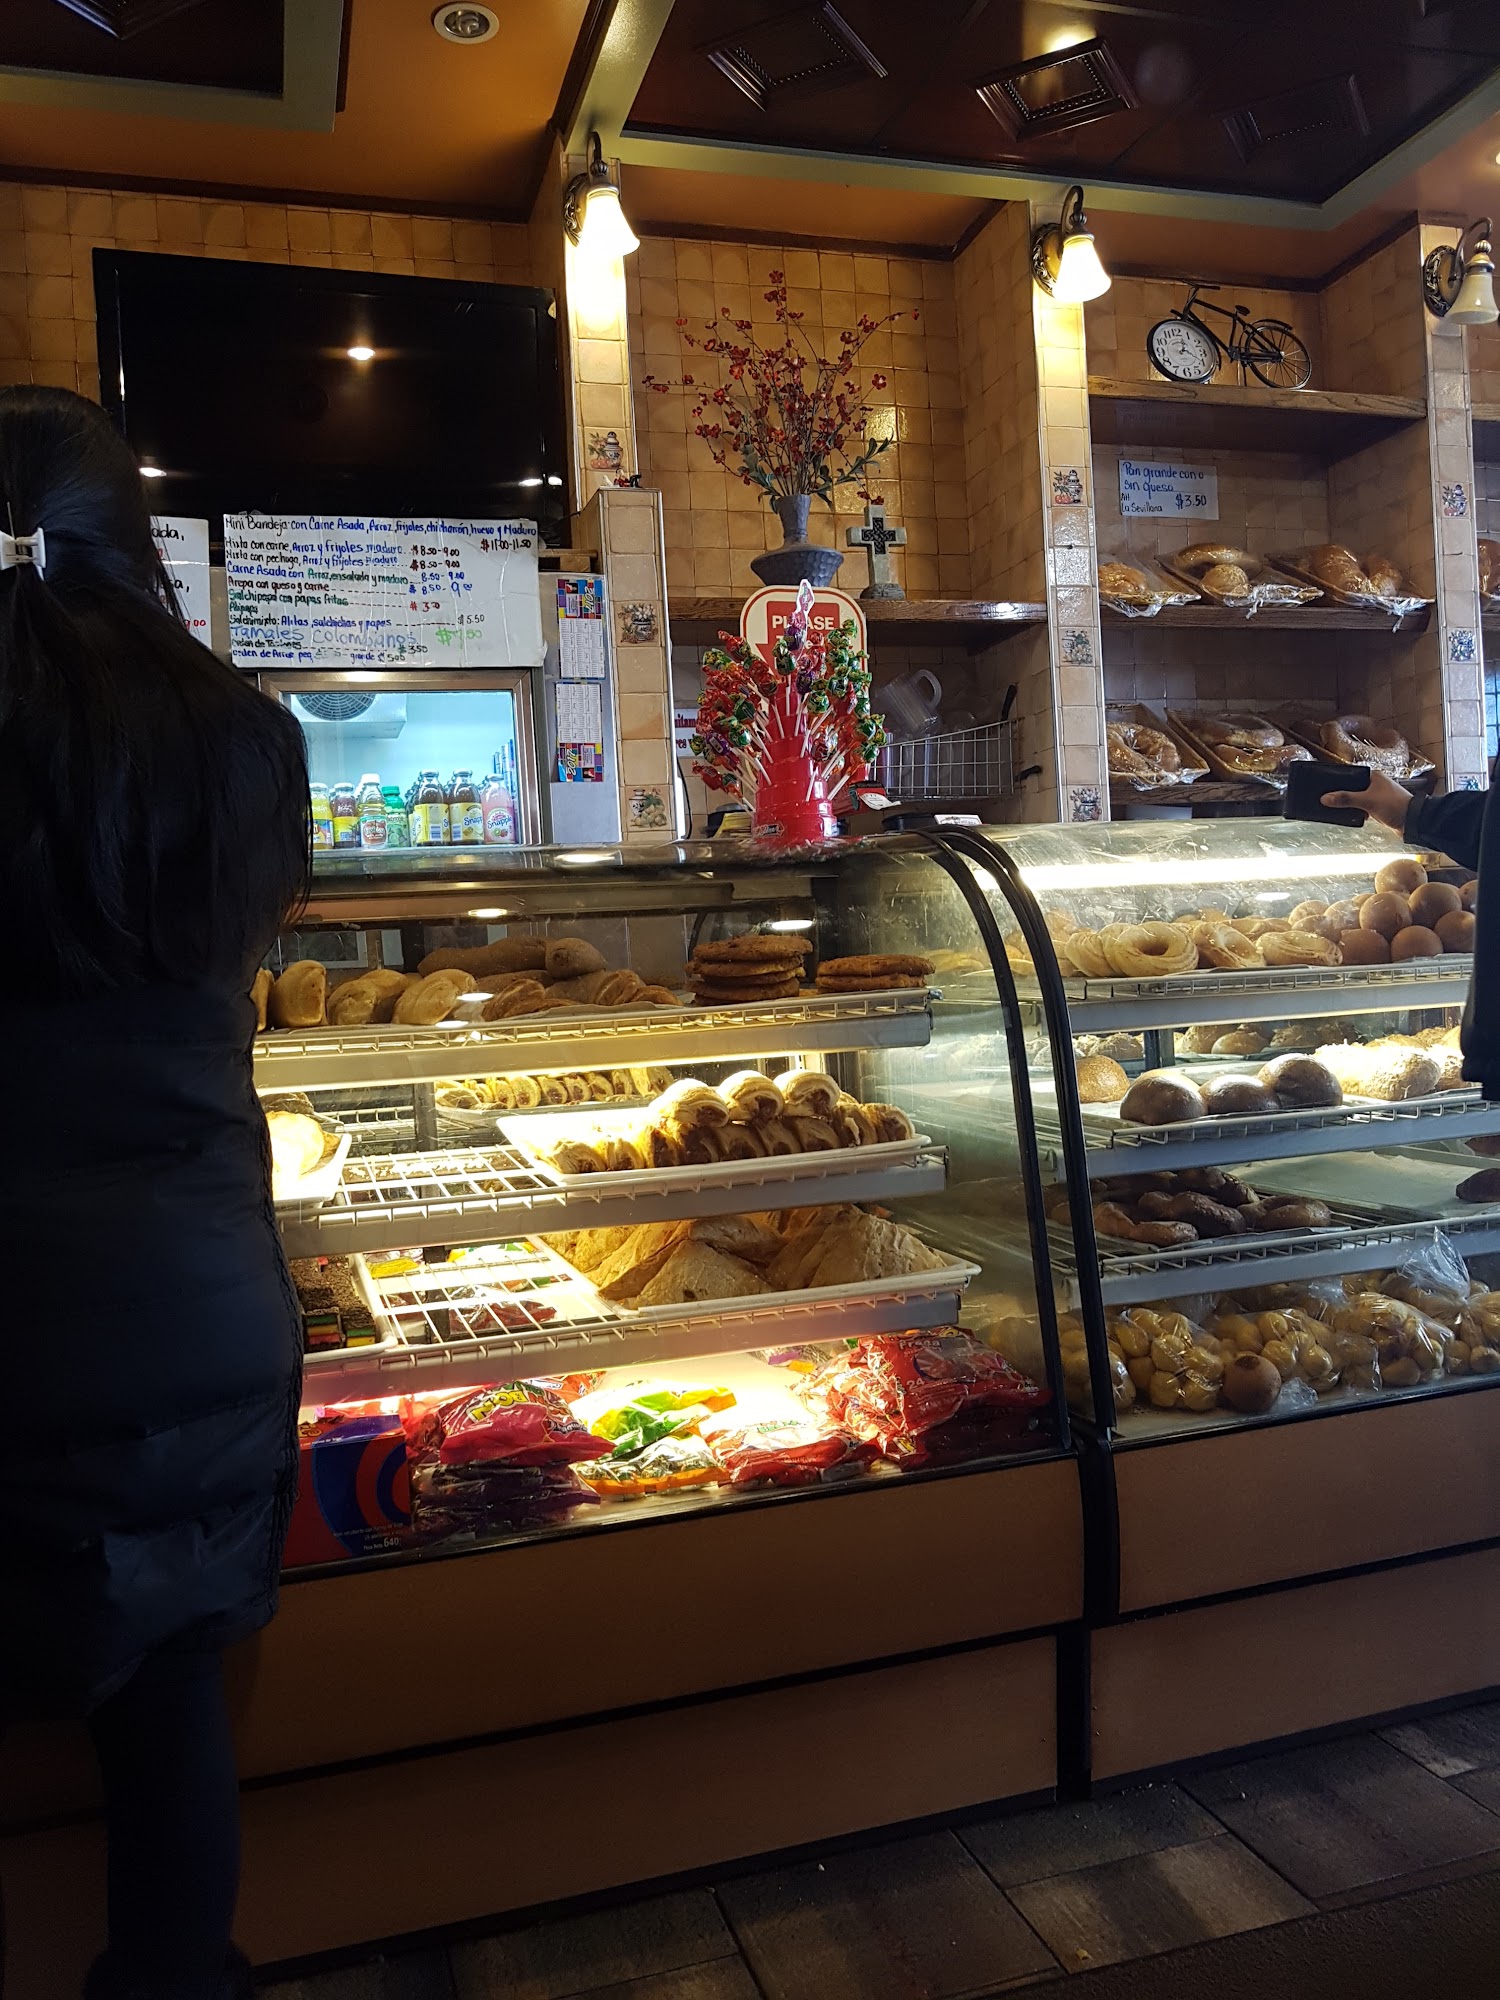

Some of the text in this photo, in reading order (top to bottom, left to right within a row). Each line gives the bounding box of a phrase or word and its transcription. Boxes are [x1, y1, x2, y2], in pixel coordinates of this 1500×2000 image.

[1122, 461, 1141, 476] Pan
[1143, 465, 1178, 483] grande
[1179, 471, 1197, 480] con
[1143, 482, 1174, 500] queso
[1175, 493, 1207, 510] $3.50
[291, 520, 308, 530] con
[292, 542, 316, 553] Arroz
[325, 539, 364, 558] frijoles
[226, 560, 255, 574] Carne
[256, 564, 287, 578] Asada
[371, 574, 378, 587] y
[584, 586, 595, 614] 2017
[230, 624, 305, 641] Tamales
[566, 749, 577, 776] 2017
[487, 815, 513, 829] Snapple
[906, 1377, 925, 1391] 24
